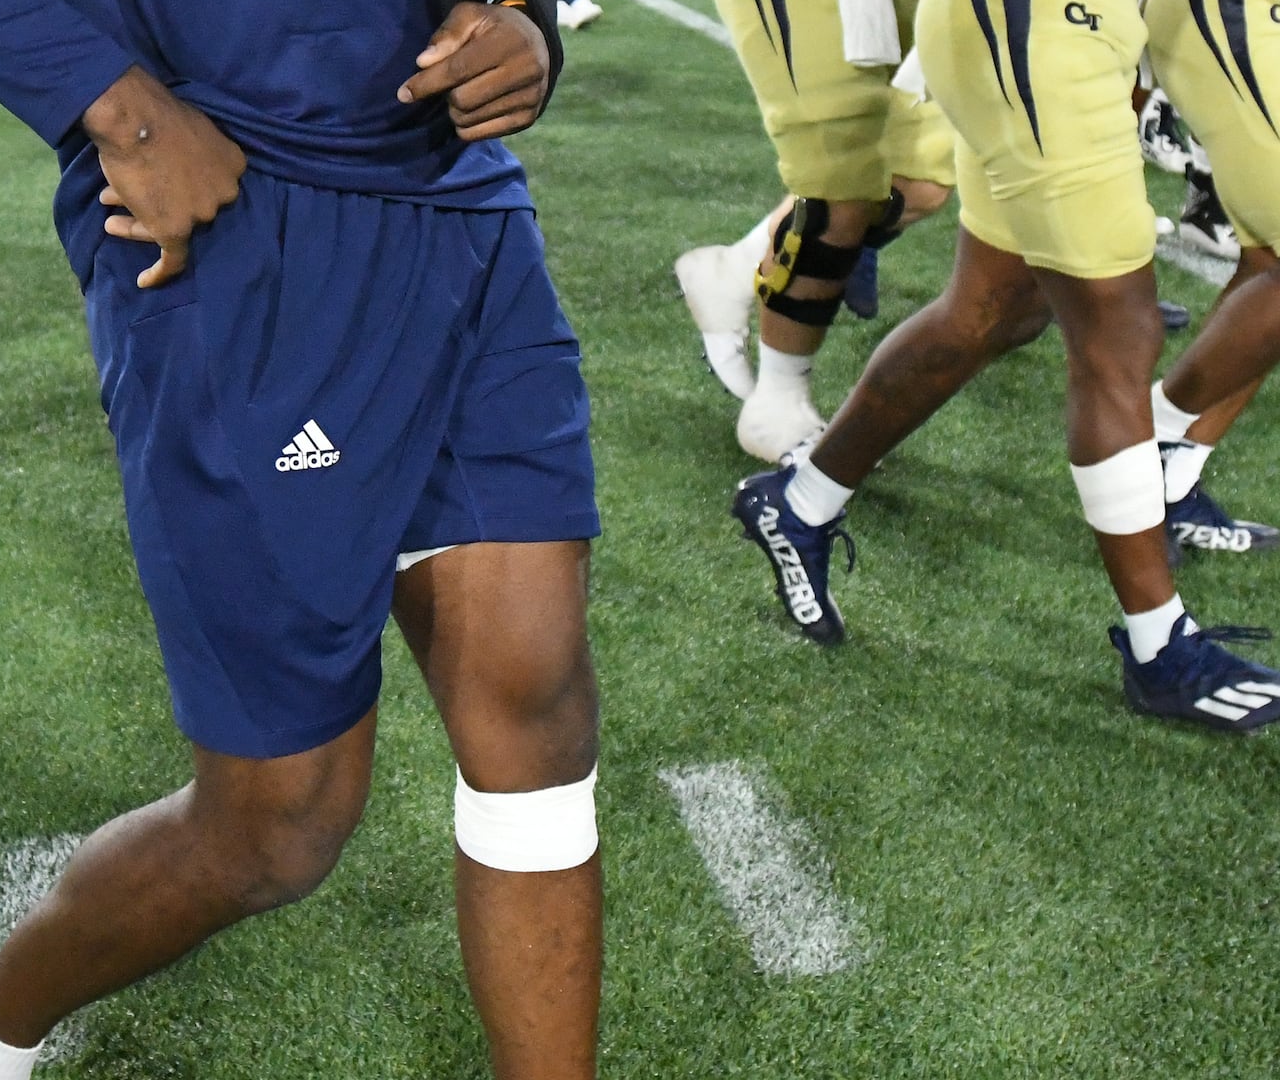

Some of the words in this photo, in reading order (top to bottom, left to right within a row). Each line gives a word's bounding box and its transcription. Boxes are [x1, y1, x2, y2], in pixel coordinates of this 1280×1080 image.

[1064, 2, 1103, 31] GT
[275, 450, 341, 472] adidas
[1172, 521, 1252, 553] ZERO
